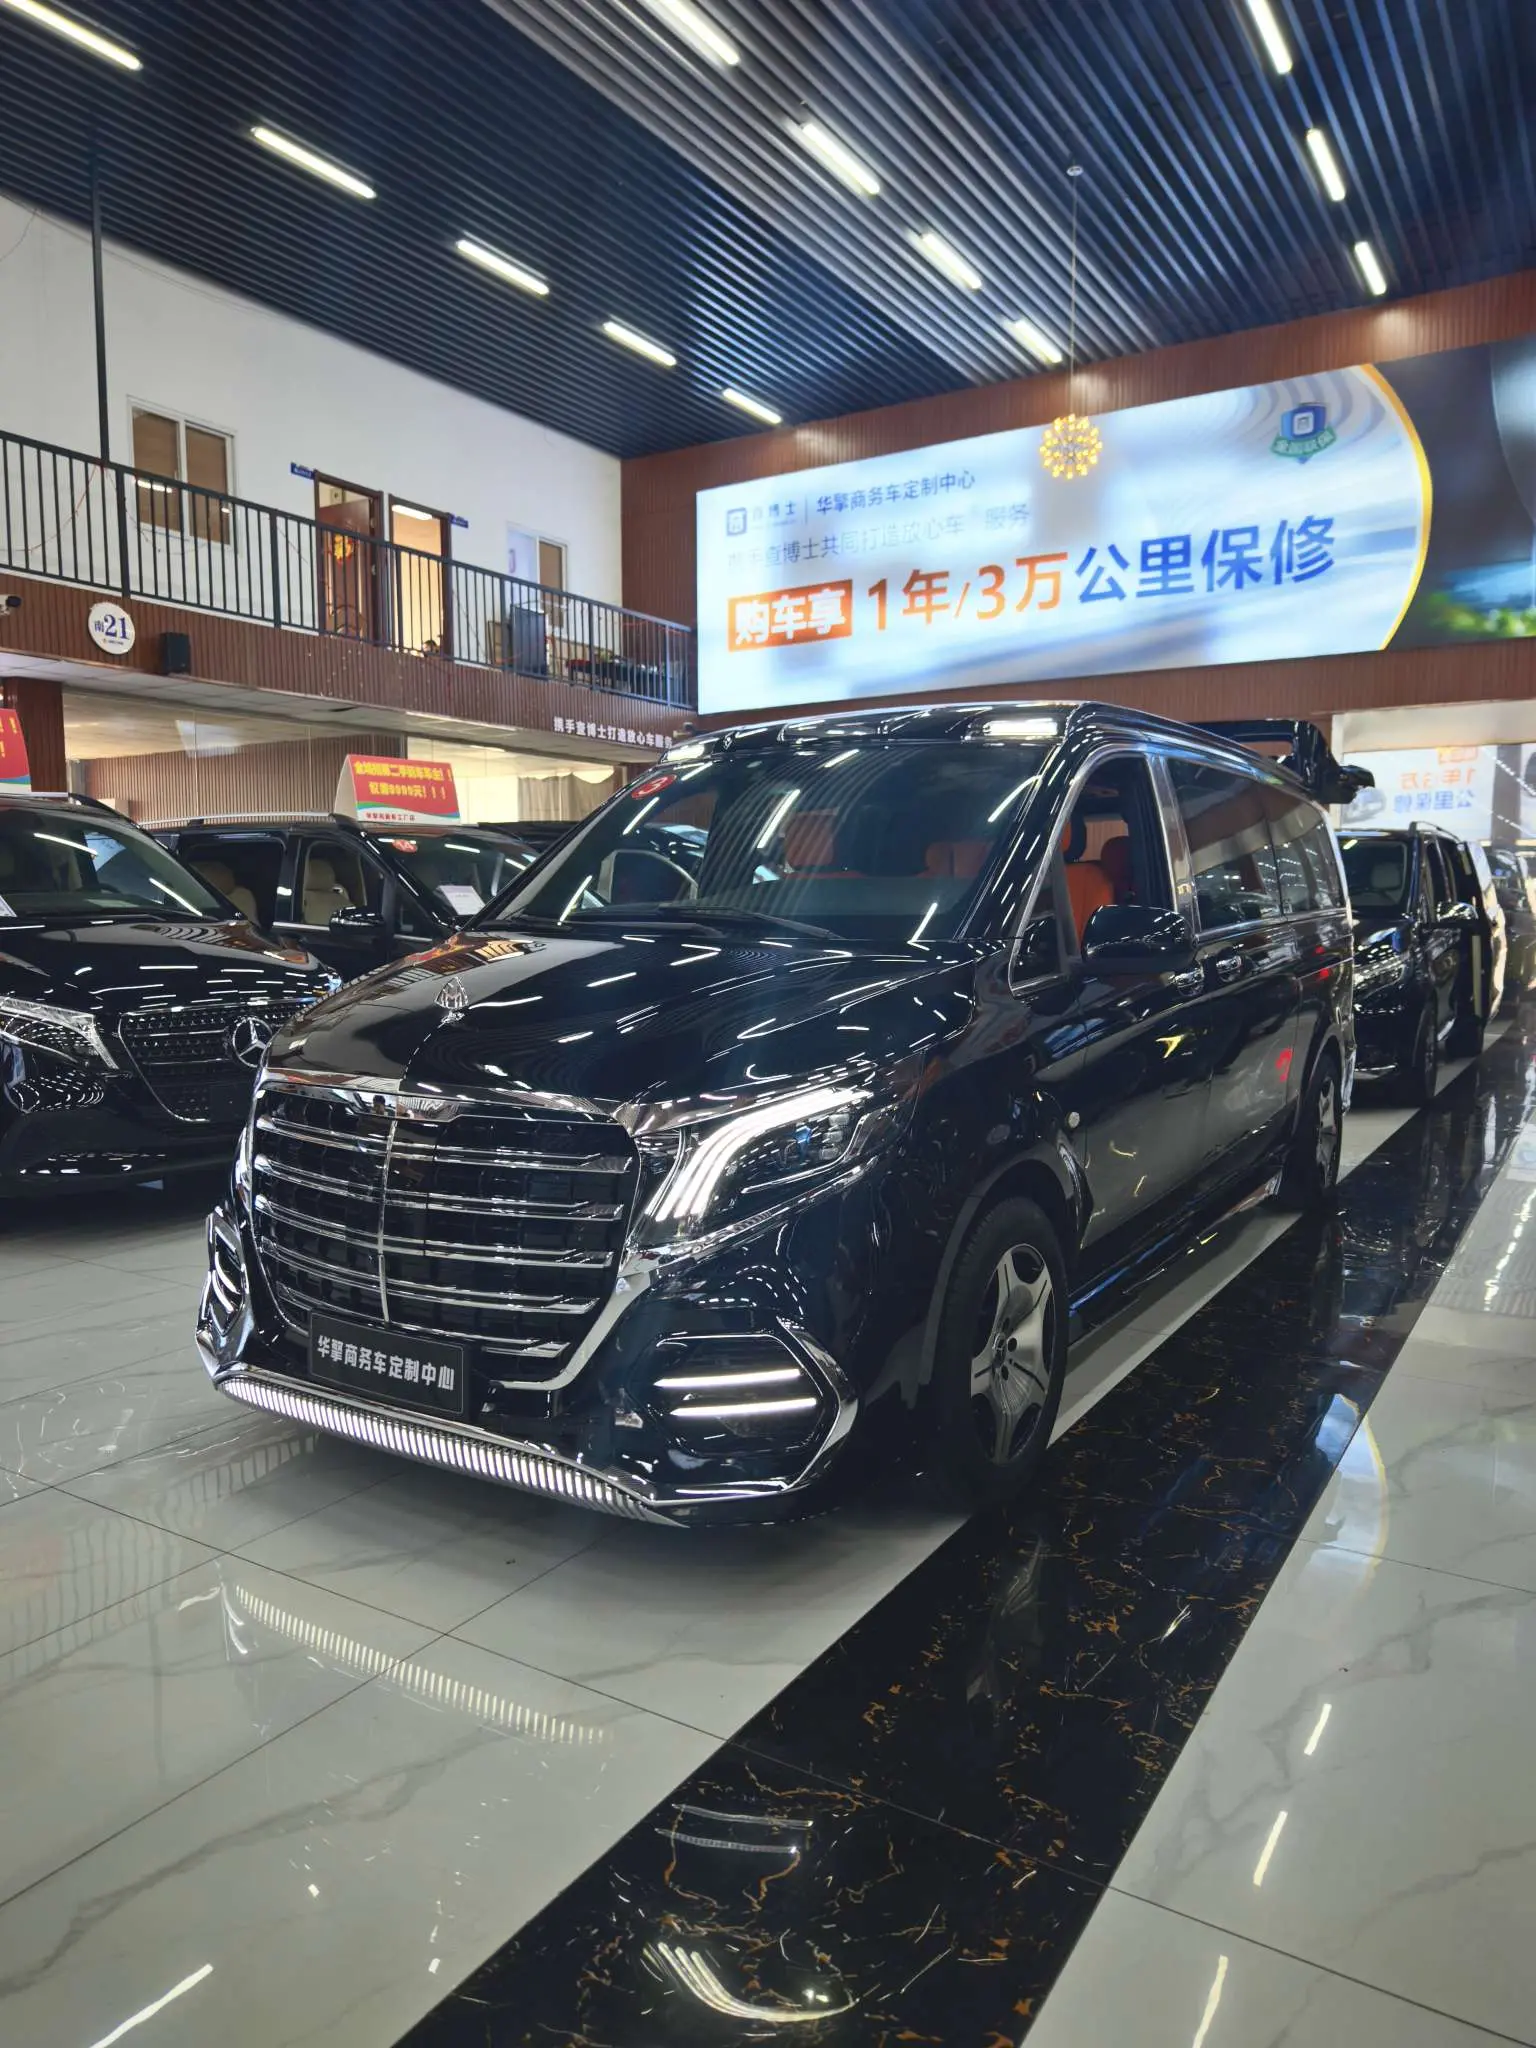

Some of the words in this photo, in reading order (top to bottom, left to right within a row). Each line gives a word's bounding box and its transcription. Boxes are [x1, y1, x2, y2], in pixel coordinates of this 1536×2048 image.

[816, 469, 976, 516] 华擎商务车定制中心
[734, 588, 846, 645] 购车享
[317, 1334, 455, 1391] 华擎商务车定制中心
